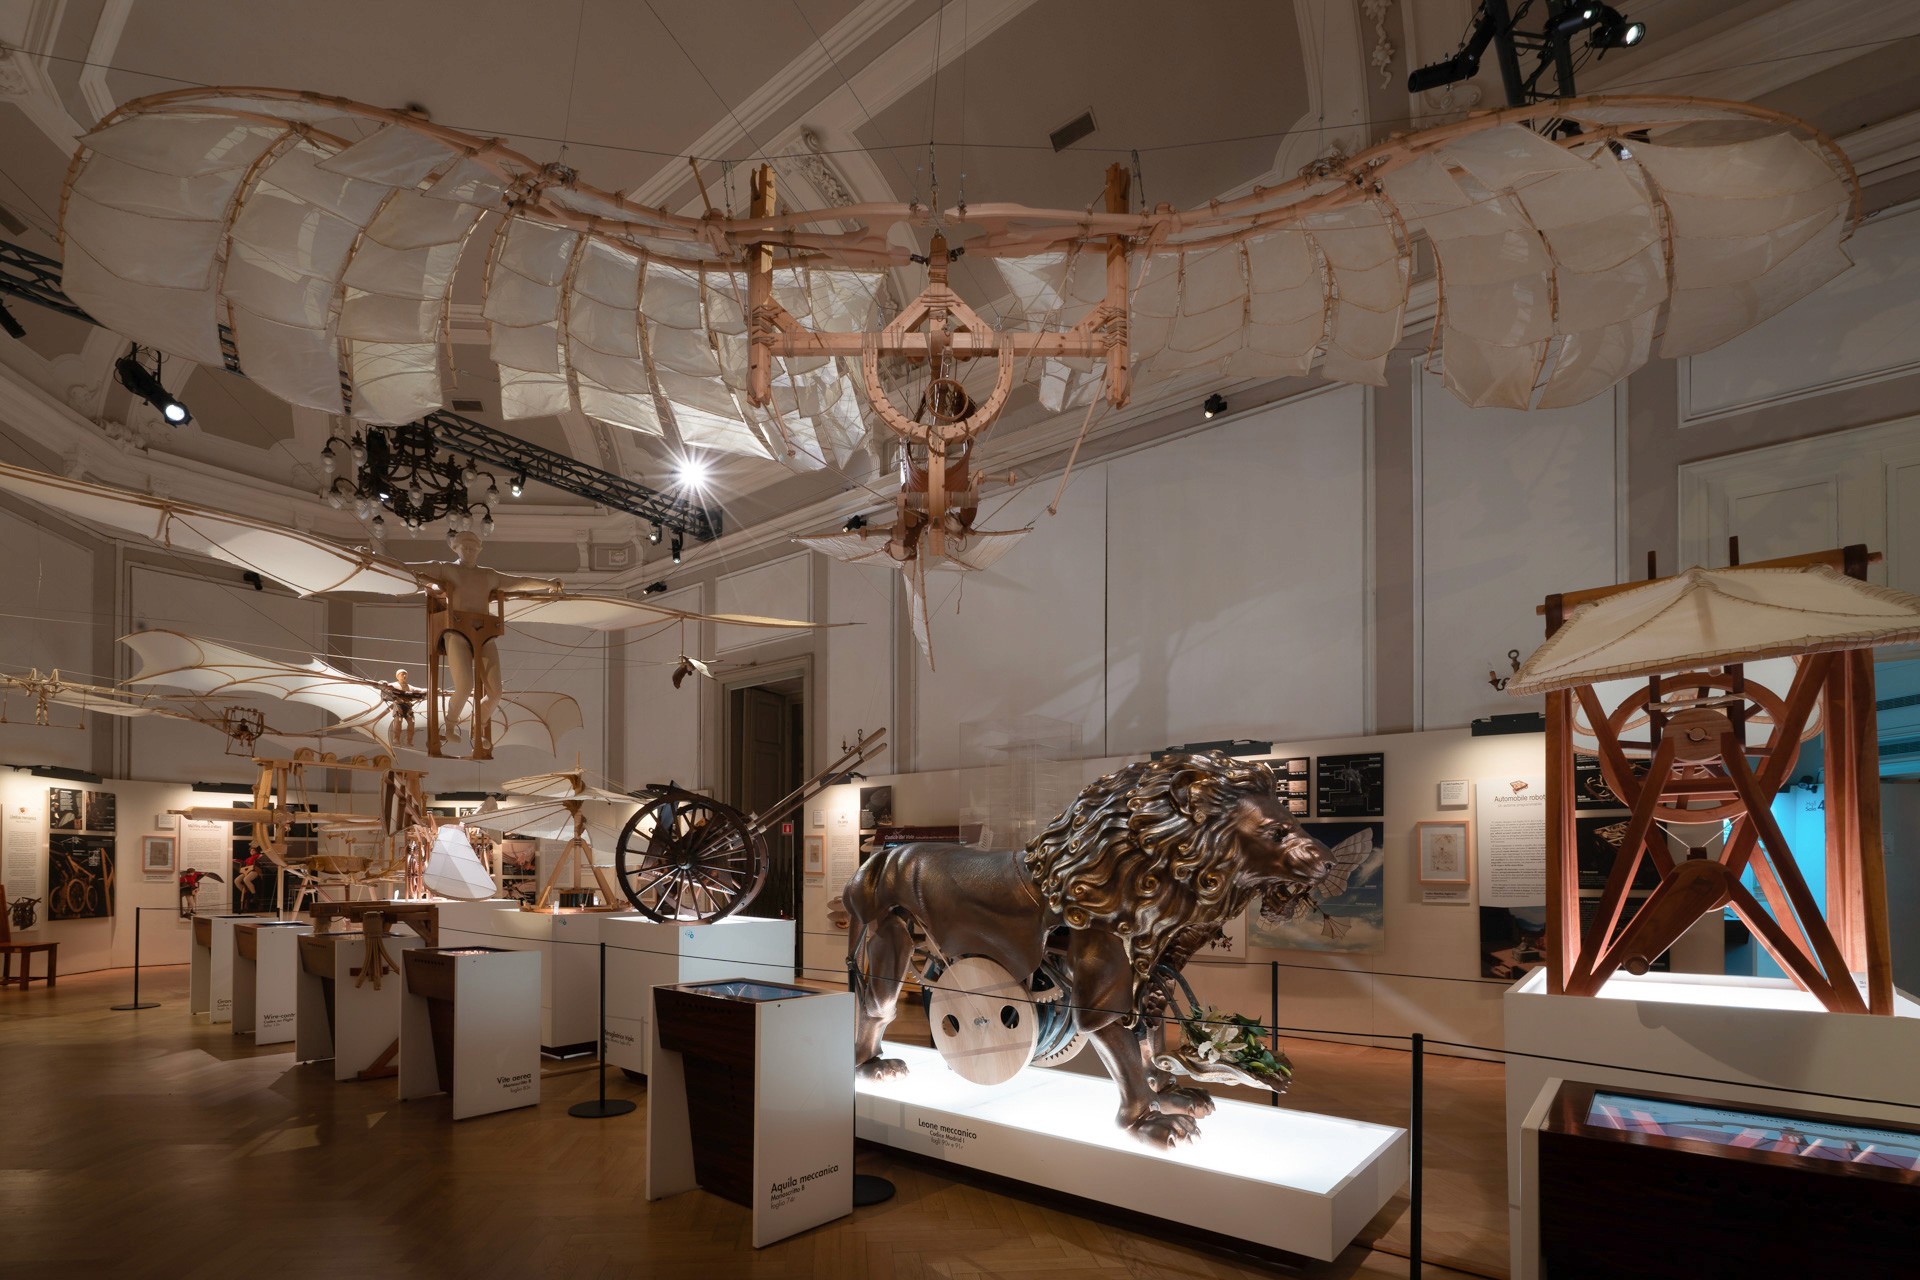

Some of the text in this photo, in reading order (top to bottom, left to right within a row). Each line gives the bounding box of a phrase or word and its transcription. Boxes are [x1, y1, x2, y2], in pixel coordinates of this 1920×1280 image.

[1494, 794, 1528, 802] Automobile
[512, 1073, 532, 1081] aerea
[918, 1118, 977, 1139] Leone meccanico
[770, 1165, 839, 1194] Aquila meccanica
[770, 1187, 801, 1202] Manoscritto
[770, 1200, 785, 1210] foglio
